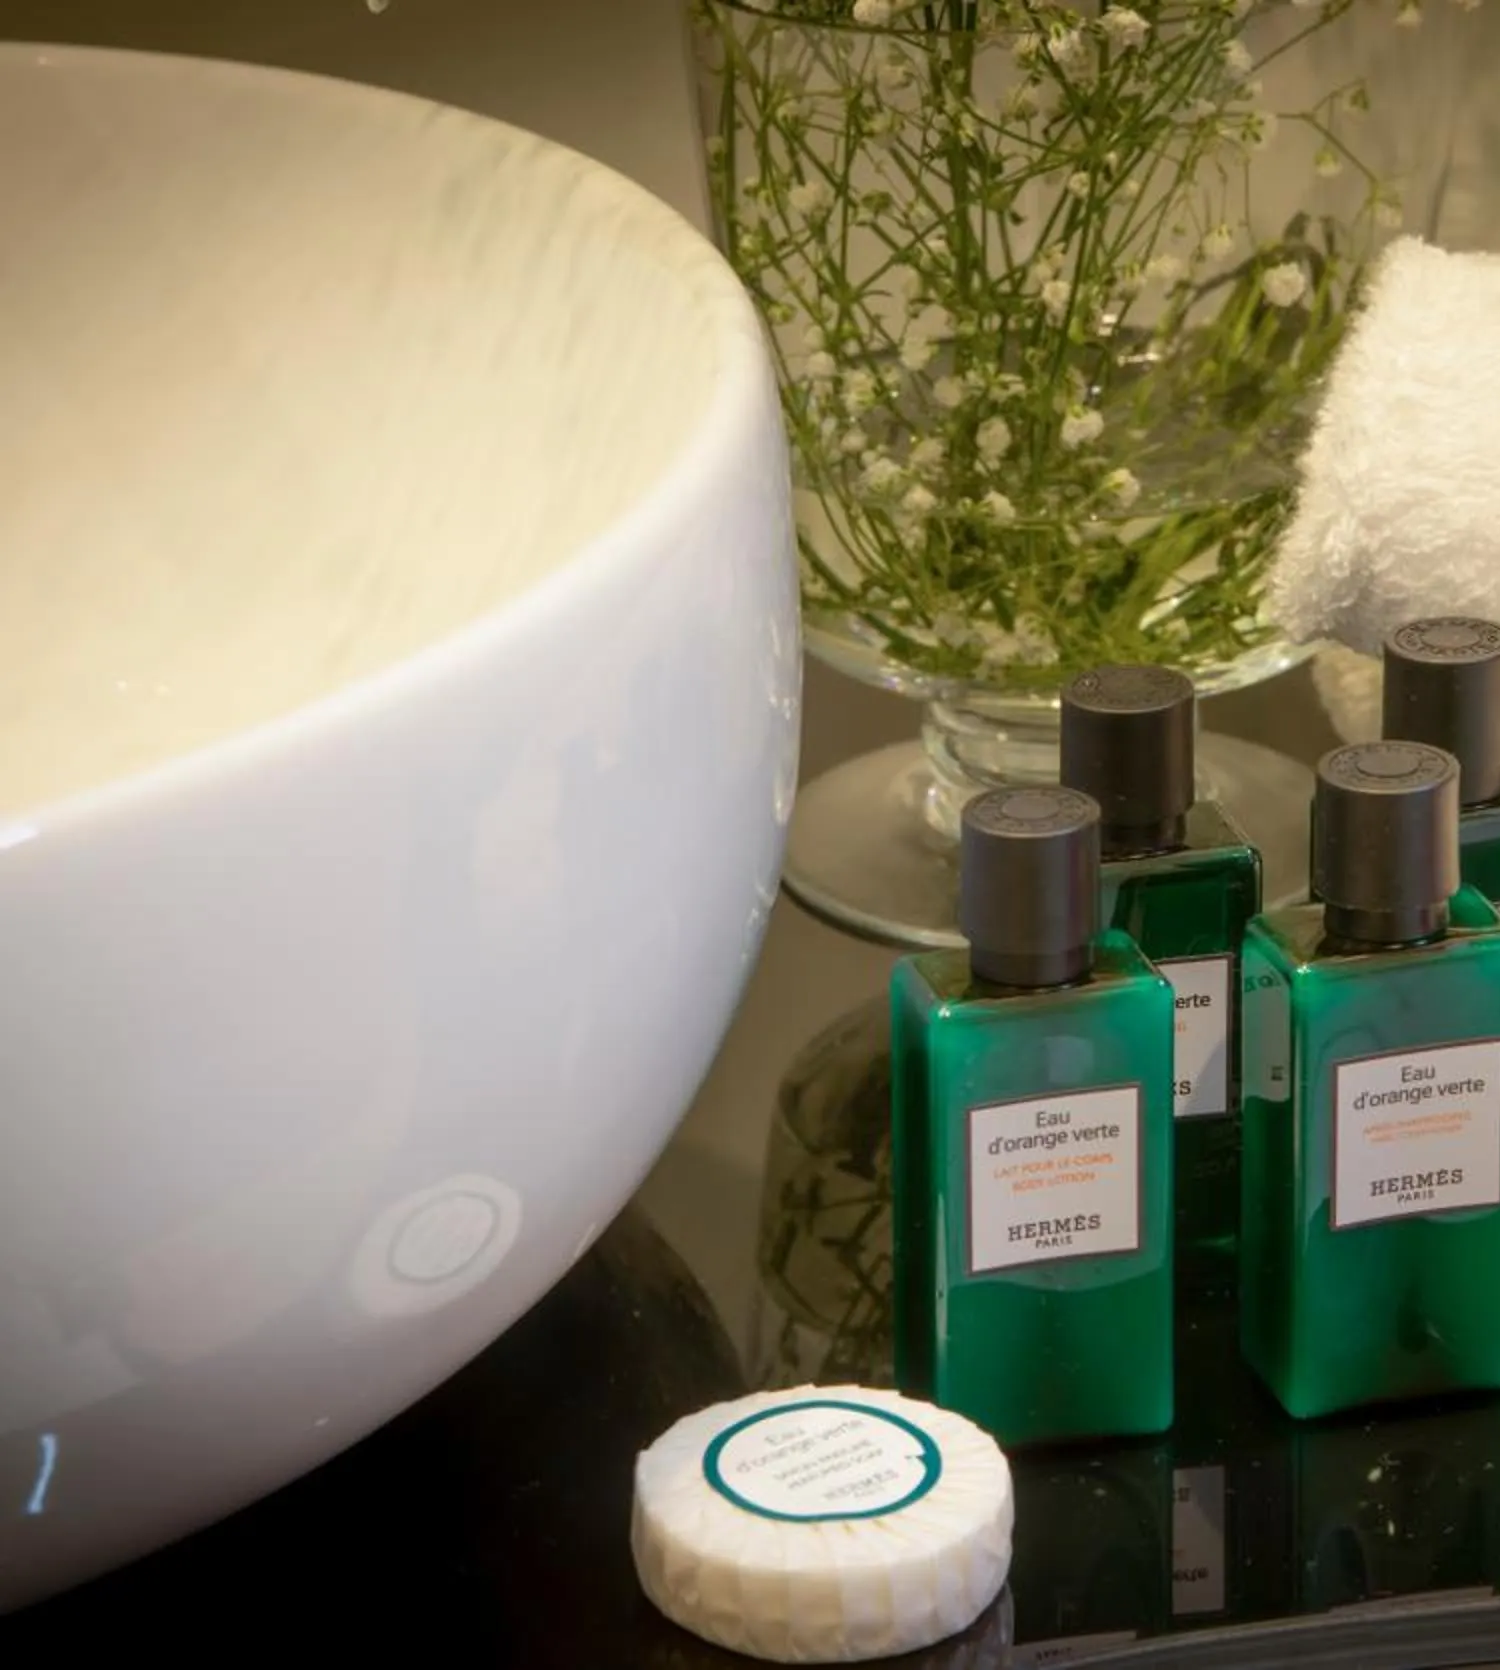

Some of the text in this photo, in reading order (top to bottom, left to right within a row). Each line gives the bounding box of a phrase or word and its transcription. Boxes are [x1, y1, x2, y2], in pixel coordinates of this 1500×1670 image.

[1175, 993, 1212, 1009] erte
[1401, 1065, 1436, 1083] Eau
[1353, 1077, 1486, 1111] d'orange verte
[1036, 1110, 1071, 1128] Eau
[988, 1124, 1121, 1155] d'orange verte
[1397, 1189, 1435, 1204] PARIS
[1035, 1235, 1073, 1249] PARIS
